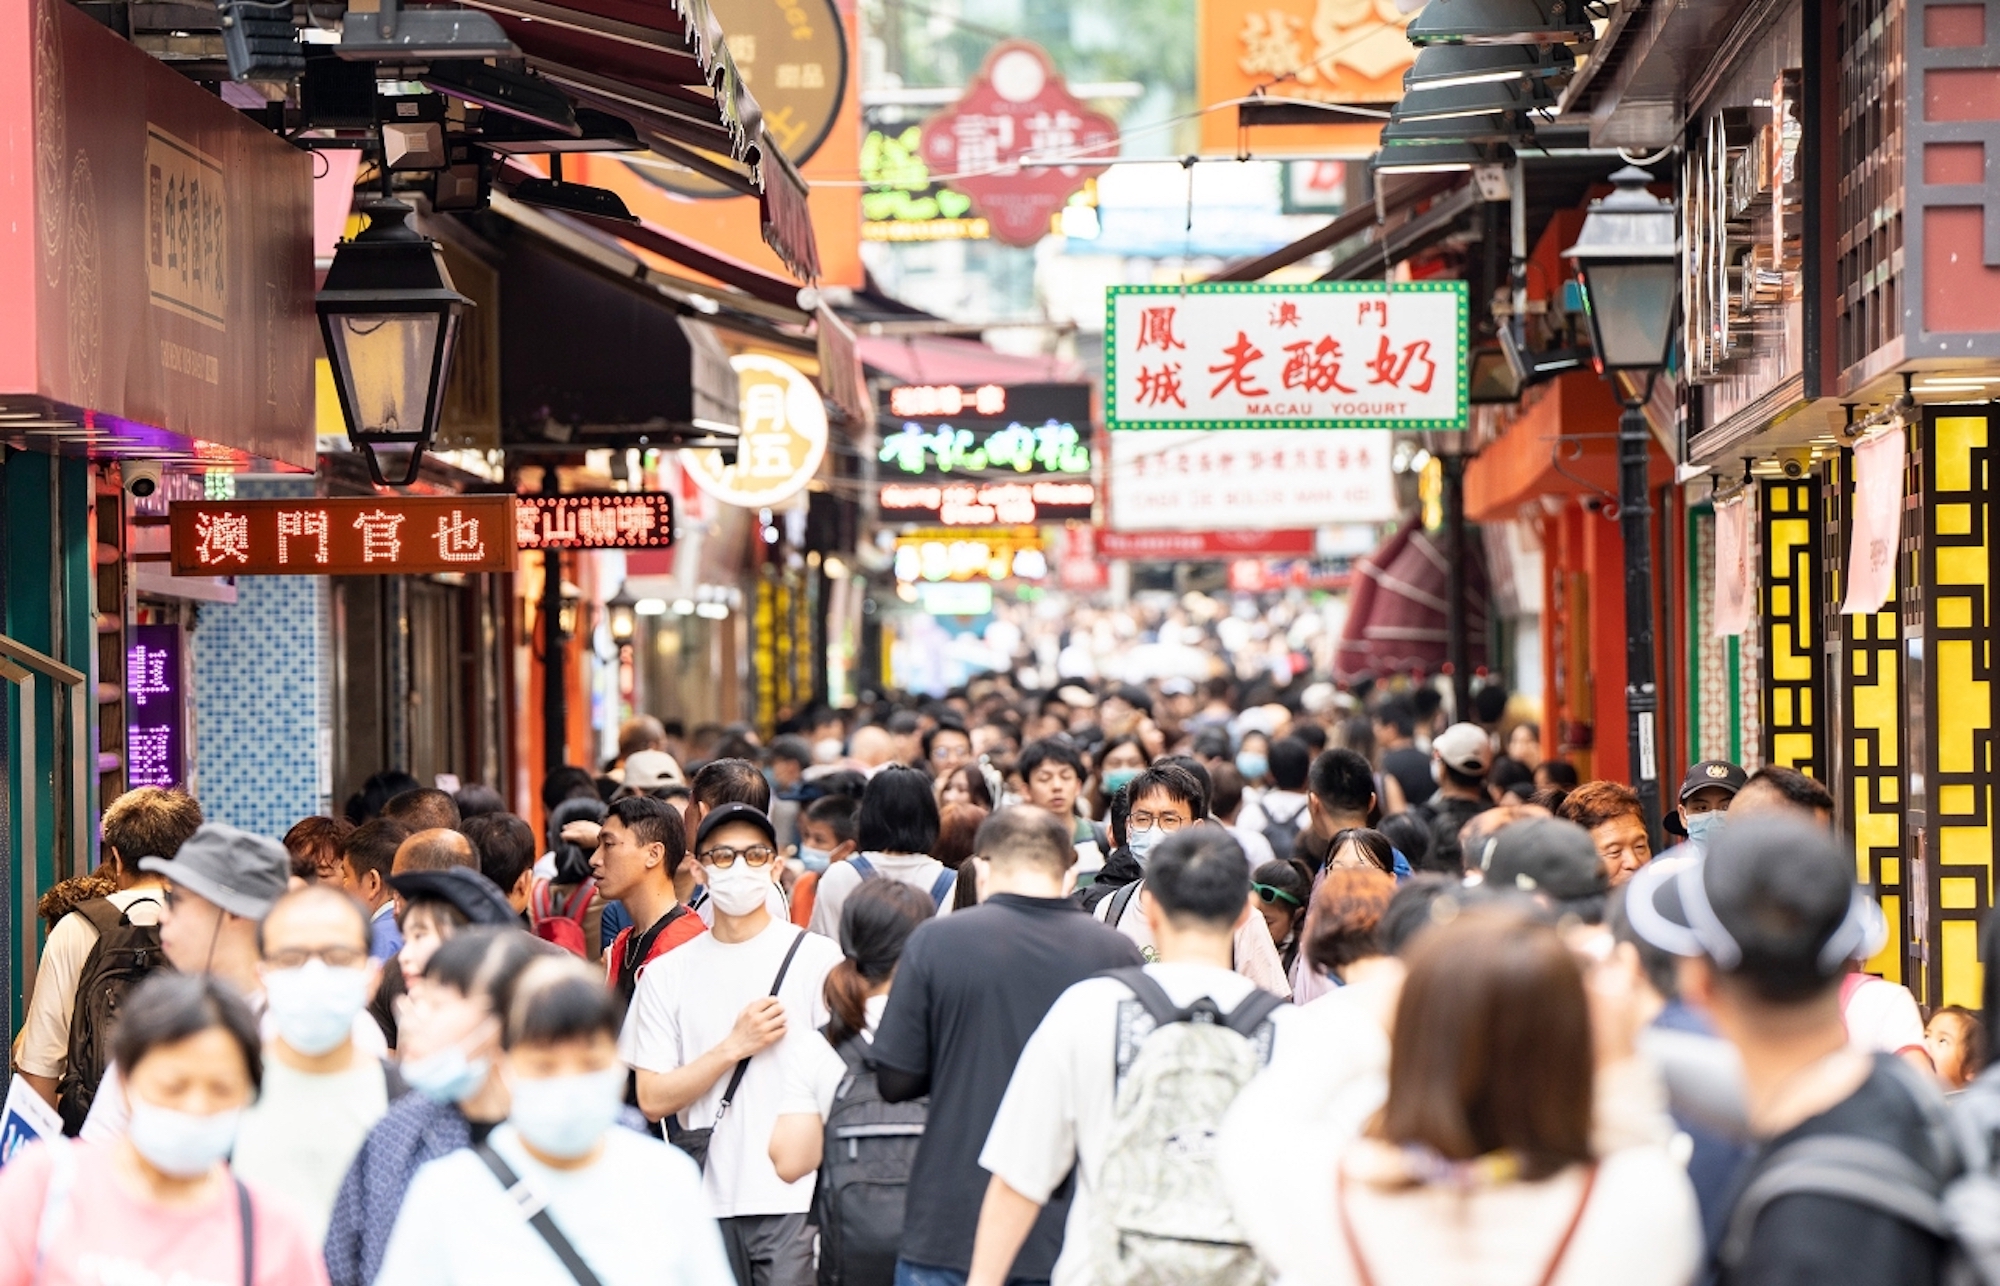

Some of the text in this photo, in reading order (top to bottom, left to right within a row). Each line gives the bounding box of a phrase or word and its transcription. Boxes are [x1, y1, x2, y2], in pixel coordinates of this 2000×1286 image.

[1135, 305, 1187, 409] 鳳城
[1208, 331, 1437, 399] 老酸奶
[1247, 402, 1408, 415] MACAU YOGURT
[194, 508, 486, 564] 澳門官也
